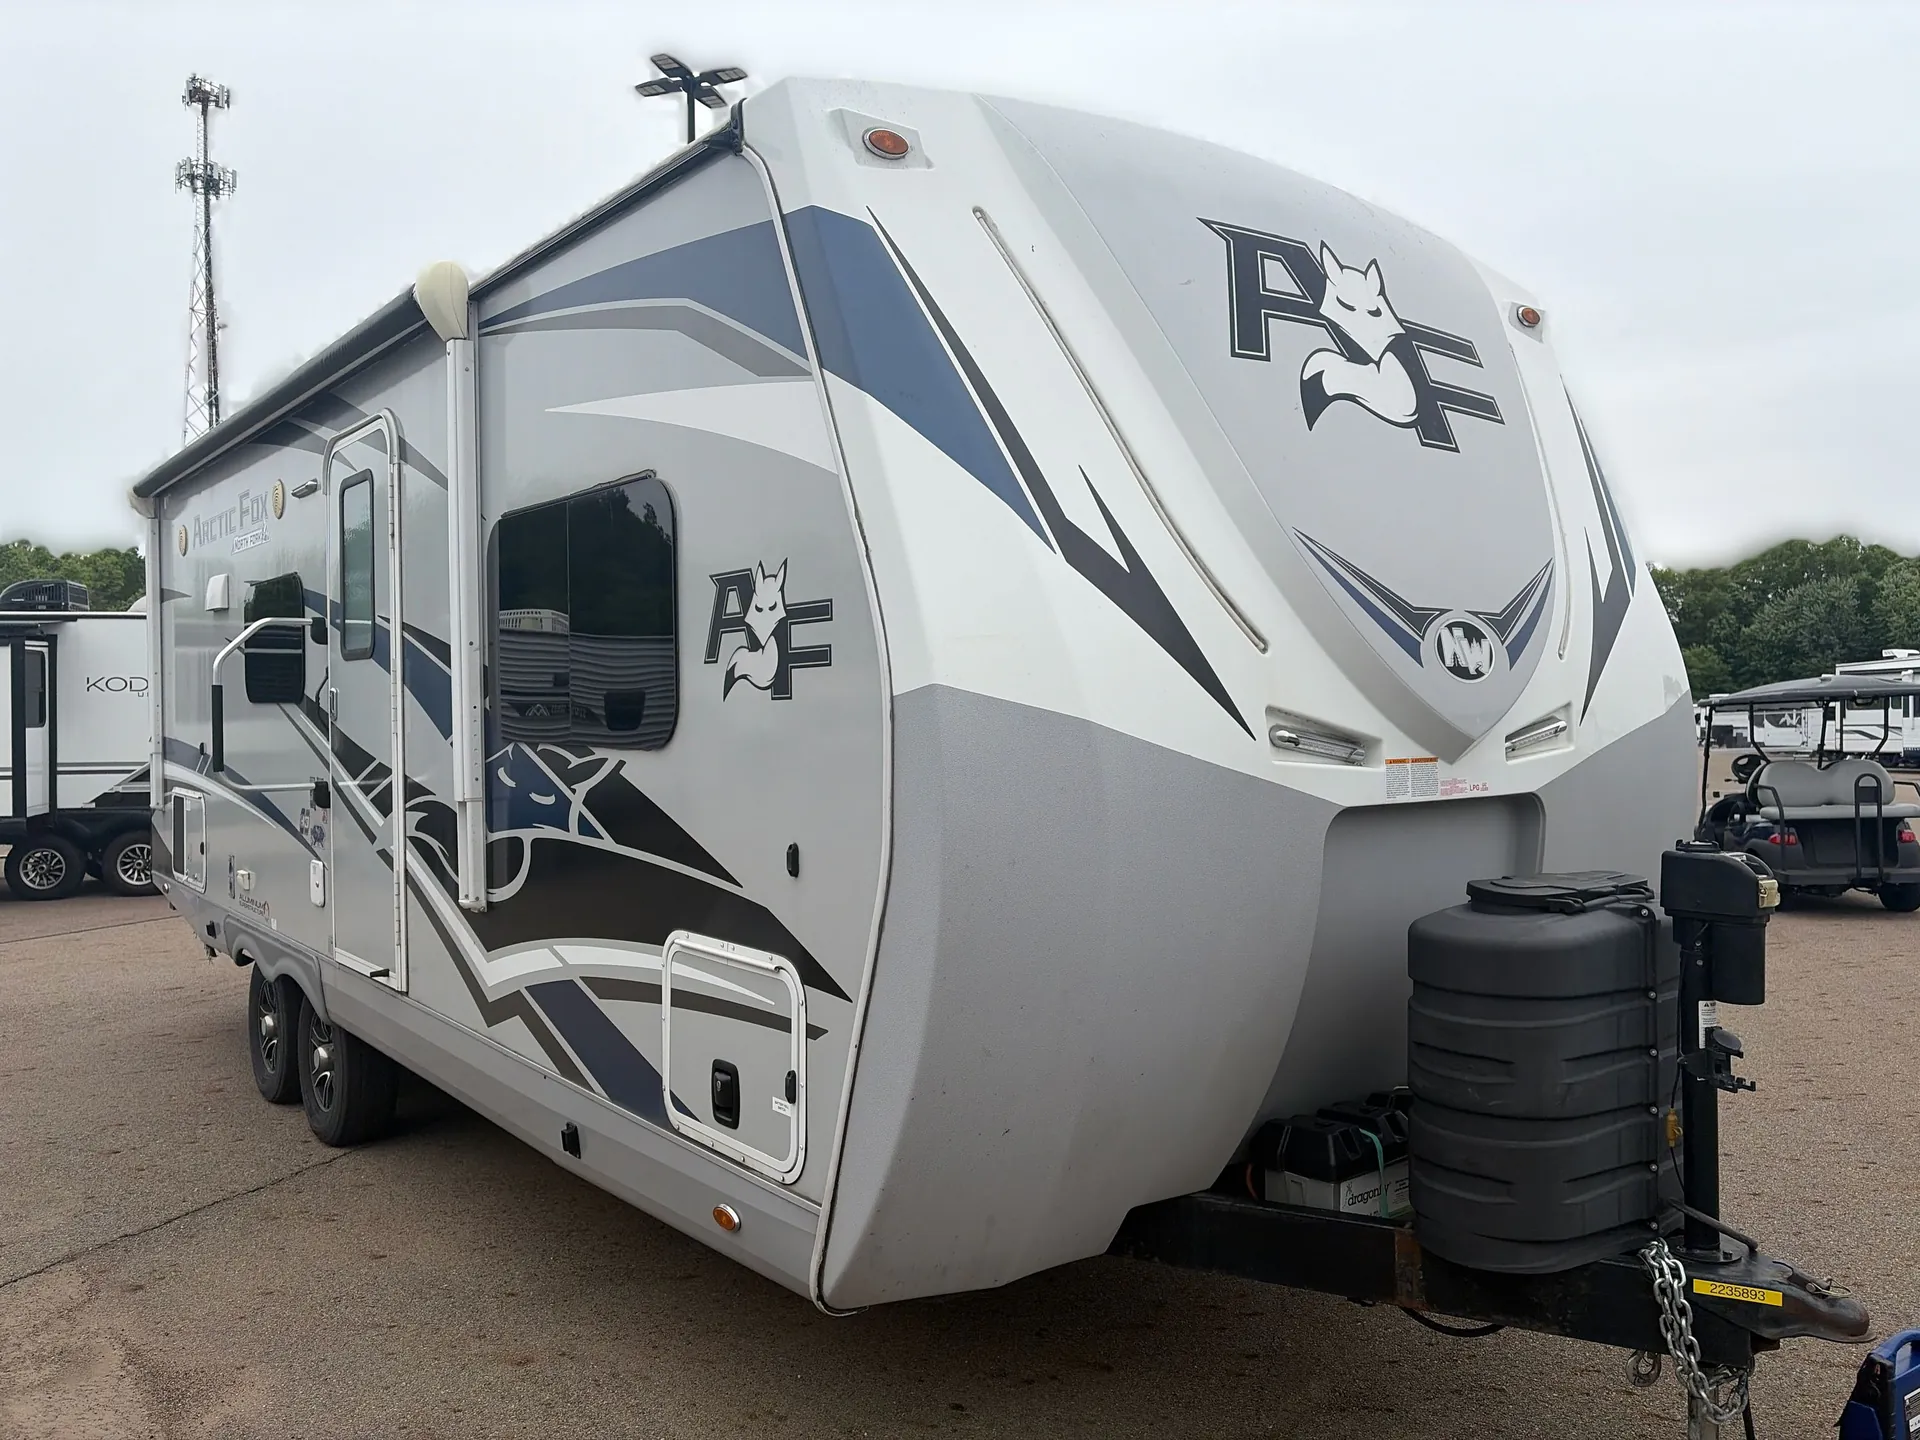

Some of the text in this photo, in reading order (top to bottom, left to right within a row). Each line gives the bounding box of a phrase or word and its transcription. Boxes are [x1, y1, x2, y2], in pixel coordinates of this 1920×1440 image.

[193, 488, 268, 550] ARCTIC FOX
[1469, 783, 1480, 792] LPG
[1347, 1182, 1391, 1206] dragony
[1710, 1283, 1766, 1301] 2235893
